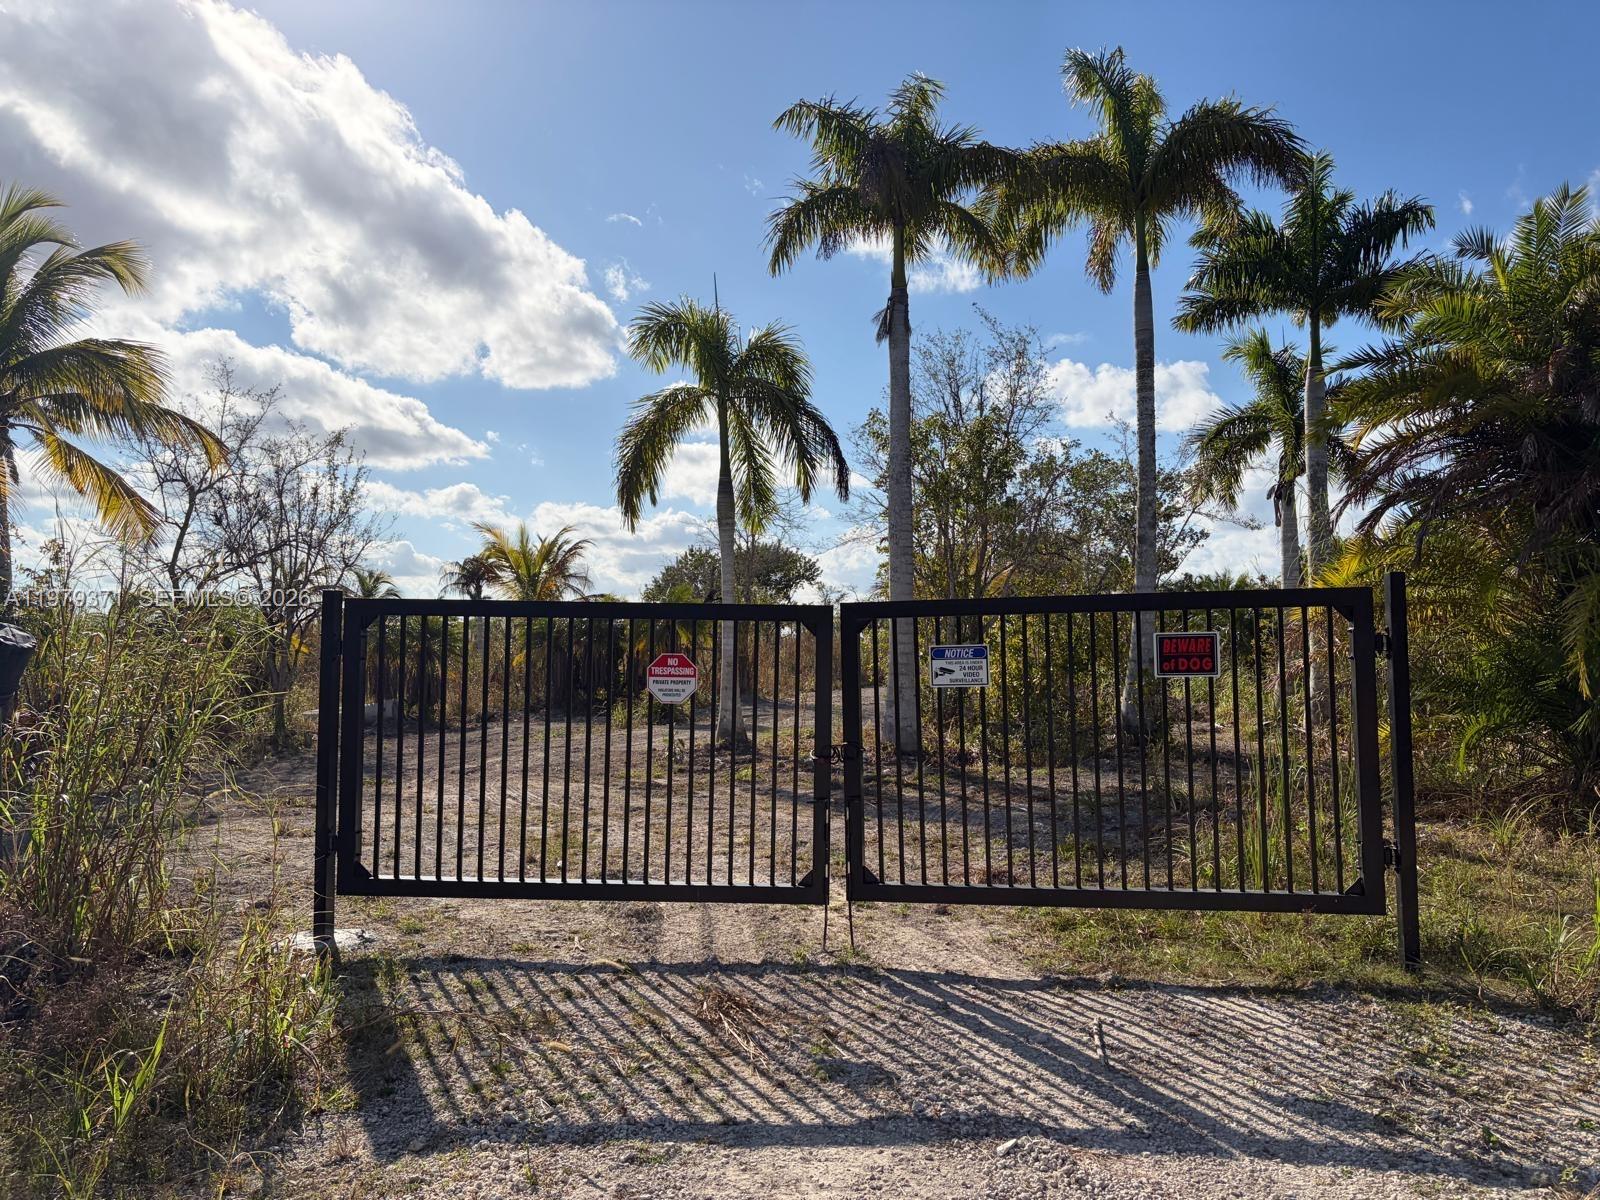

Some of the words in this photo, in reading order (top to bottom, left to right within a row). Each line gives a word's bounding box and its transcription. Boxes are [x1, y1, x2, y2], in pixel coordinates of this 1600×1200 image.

[1163, 639, 1211, 653] BEWARE
[944, 648, 975, 658] NOTICE
[667, 657, 679, 666] NO
[1163, 659, 1175, 670] of
[1179, 657, 1212, 670] DOG
[651, 667, 695, 675] TRESPASSING
